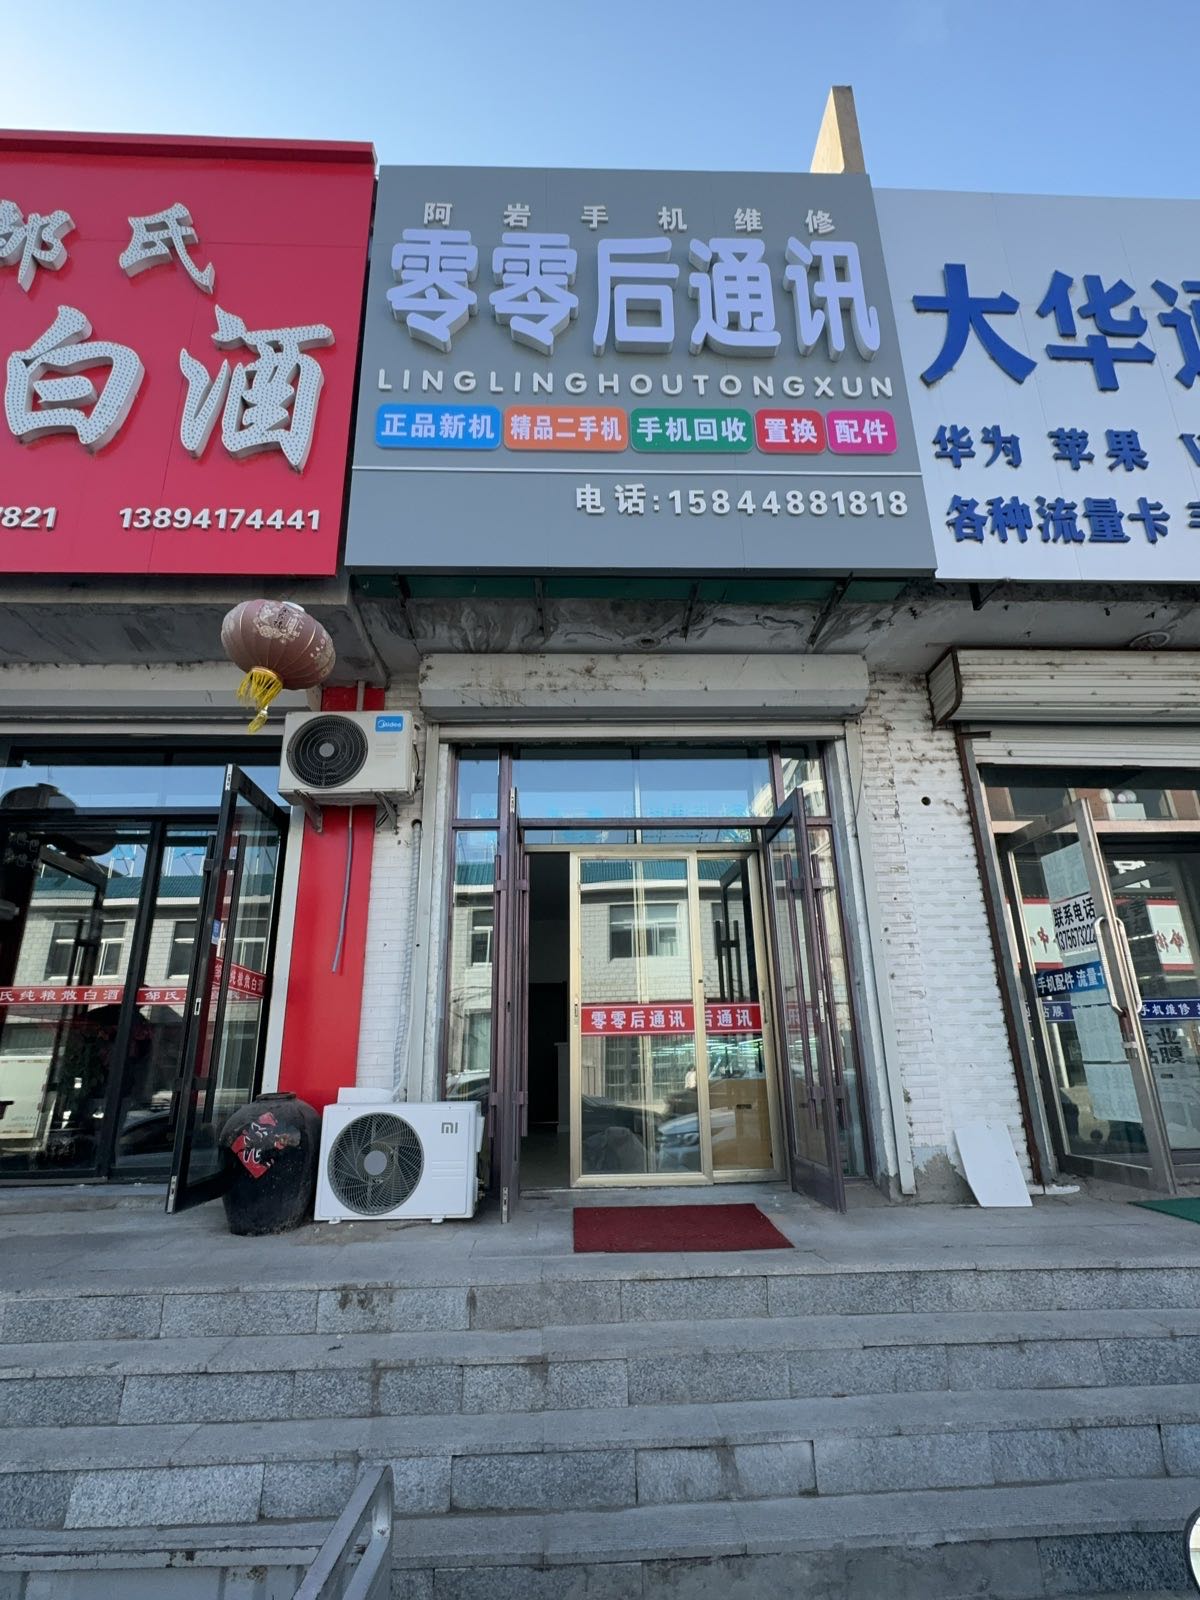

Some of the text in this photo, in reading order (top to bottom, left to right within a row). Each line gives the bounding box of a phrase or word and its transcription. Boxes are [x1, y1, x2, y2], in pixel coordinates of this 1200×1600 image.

[423, 202, 836, 235] 阿岩手机维修
[386, 228, 881, 361] 零零后通讯
[5, 304, 335, 474] 白酒
[378, 369, 894, 398] LINGLINGHOUTONGXUN
[381, 412, 888, 445] 正品新机 精品二手机 手机回收 置换 配件
[932, 425, 1022, 469] 华为
[1047, 427, 1149, 471] 苹果
[0, 506, 320, 531] 821 13894174441
[946, 494, 1171, 544] 各种流量卡
[1053, 897, 1096, 928] 联系电话
[1055, 923, 1097, 950] 1375673222
[144, 990, 186, 1001] 邹氏
[1037, 972, 1075, 994] 手机配件
[591, 1010, 686, 1029] 零零后通讯
